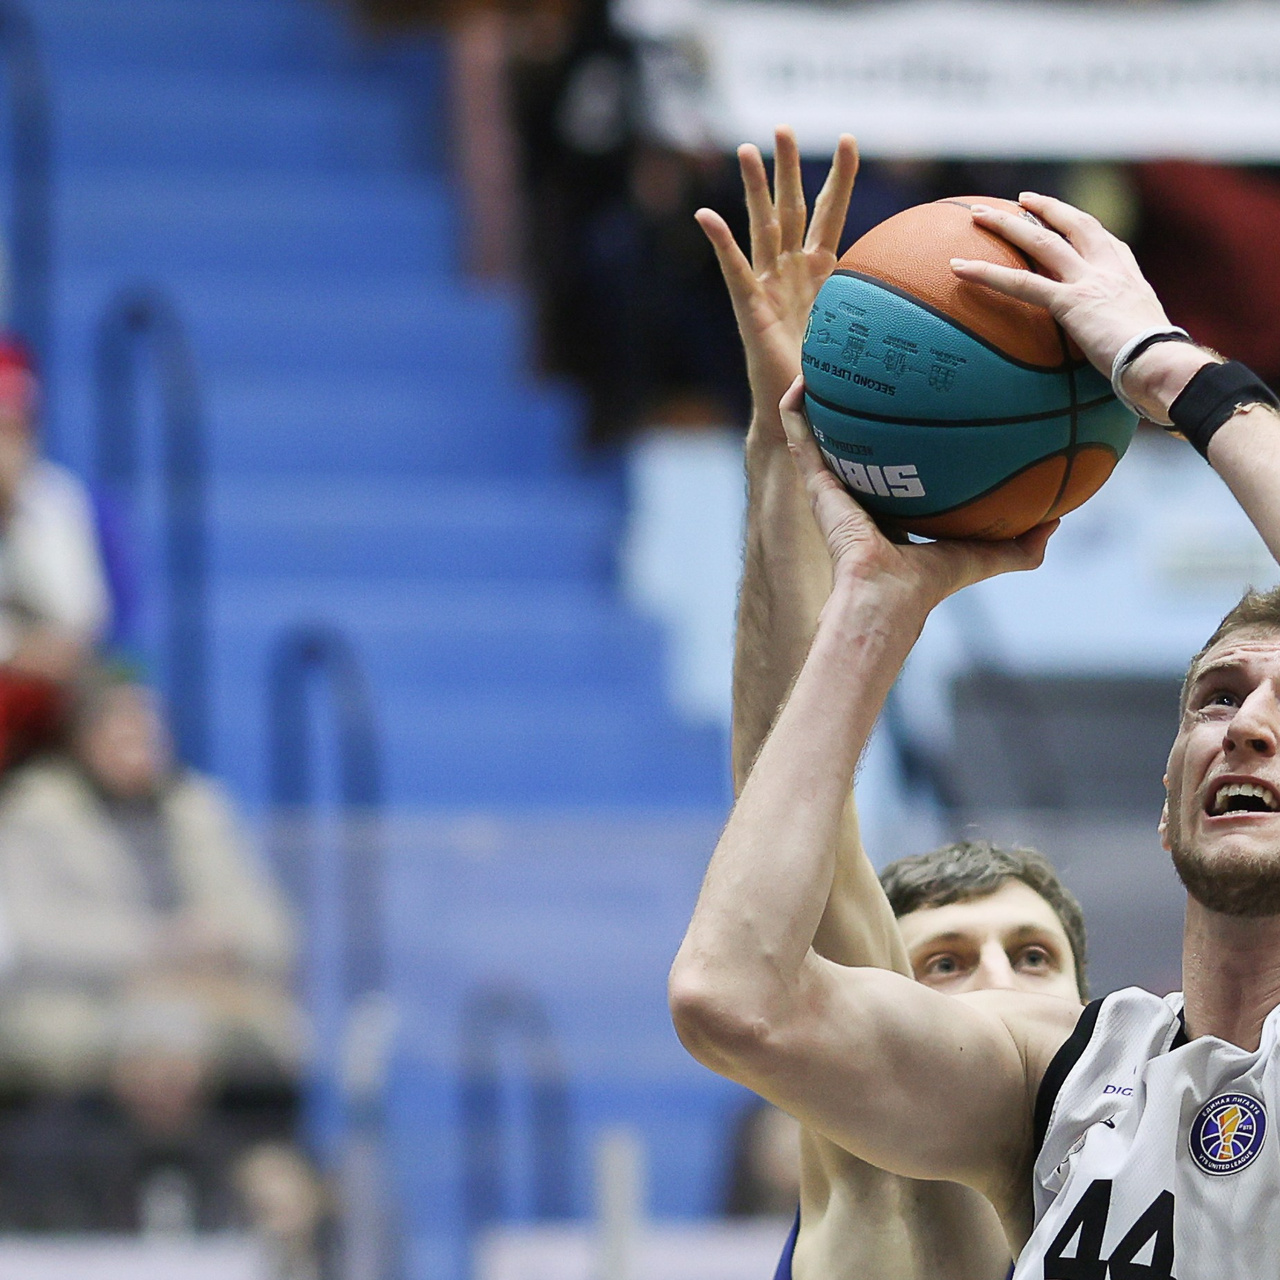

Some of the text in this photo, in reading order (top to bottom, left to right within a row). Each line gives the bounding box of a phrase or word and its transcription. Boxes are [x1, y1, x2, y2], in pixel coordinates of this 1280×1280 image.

[820, 362, 832, 375] OF
[832, 366, 853, 384] LIFE
[852, 373, 896, 397] SECOND
[1103, 1084, 1134, 1097] DIG
[1208, 1161, 1230, 1170] UNITED
[1230, 1150, 1254, 1168] LEAGUE
